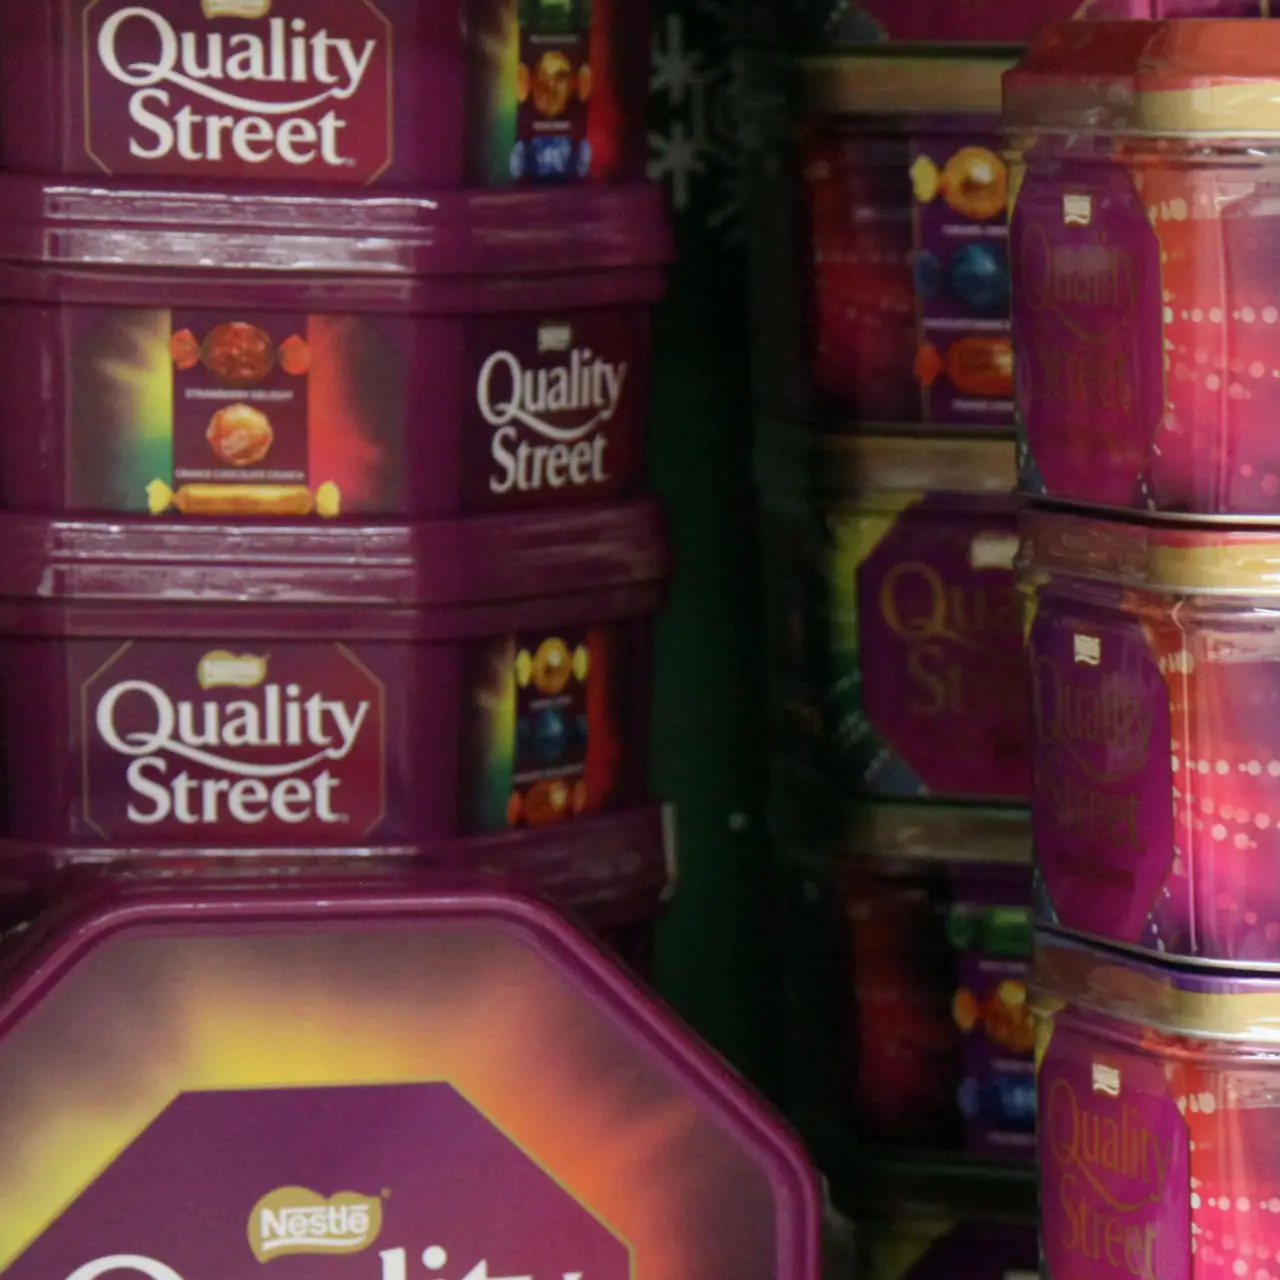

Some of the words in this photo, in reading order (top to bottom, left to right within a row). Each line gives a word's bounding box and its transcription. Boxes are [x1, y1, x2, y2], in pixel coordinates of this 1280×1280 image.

[97, 7, 376, 113] Quality
[128, 89, 350, 165] Street
[477, 349, 626, 441] Quality
[490, 428, 610, 494] Street
[97, 680, 370, 776] Quality
[126, 756, 344, 824] Street
[260, 1202, 370, 1240] Nestlé
